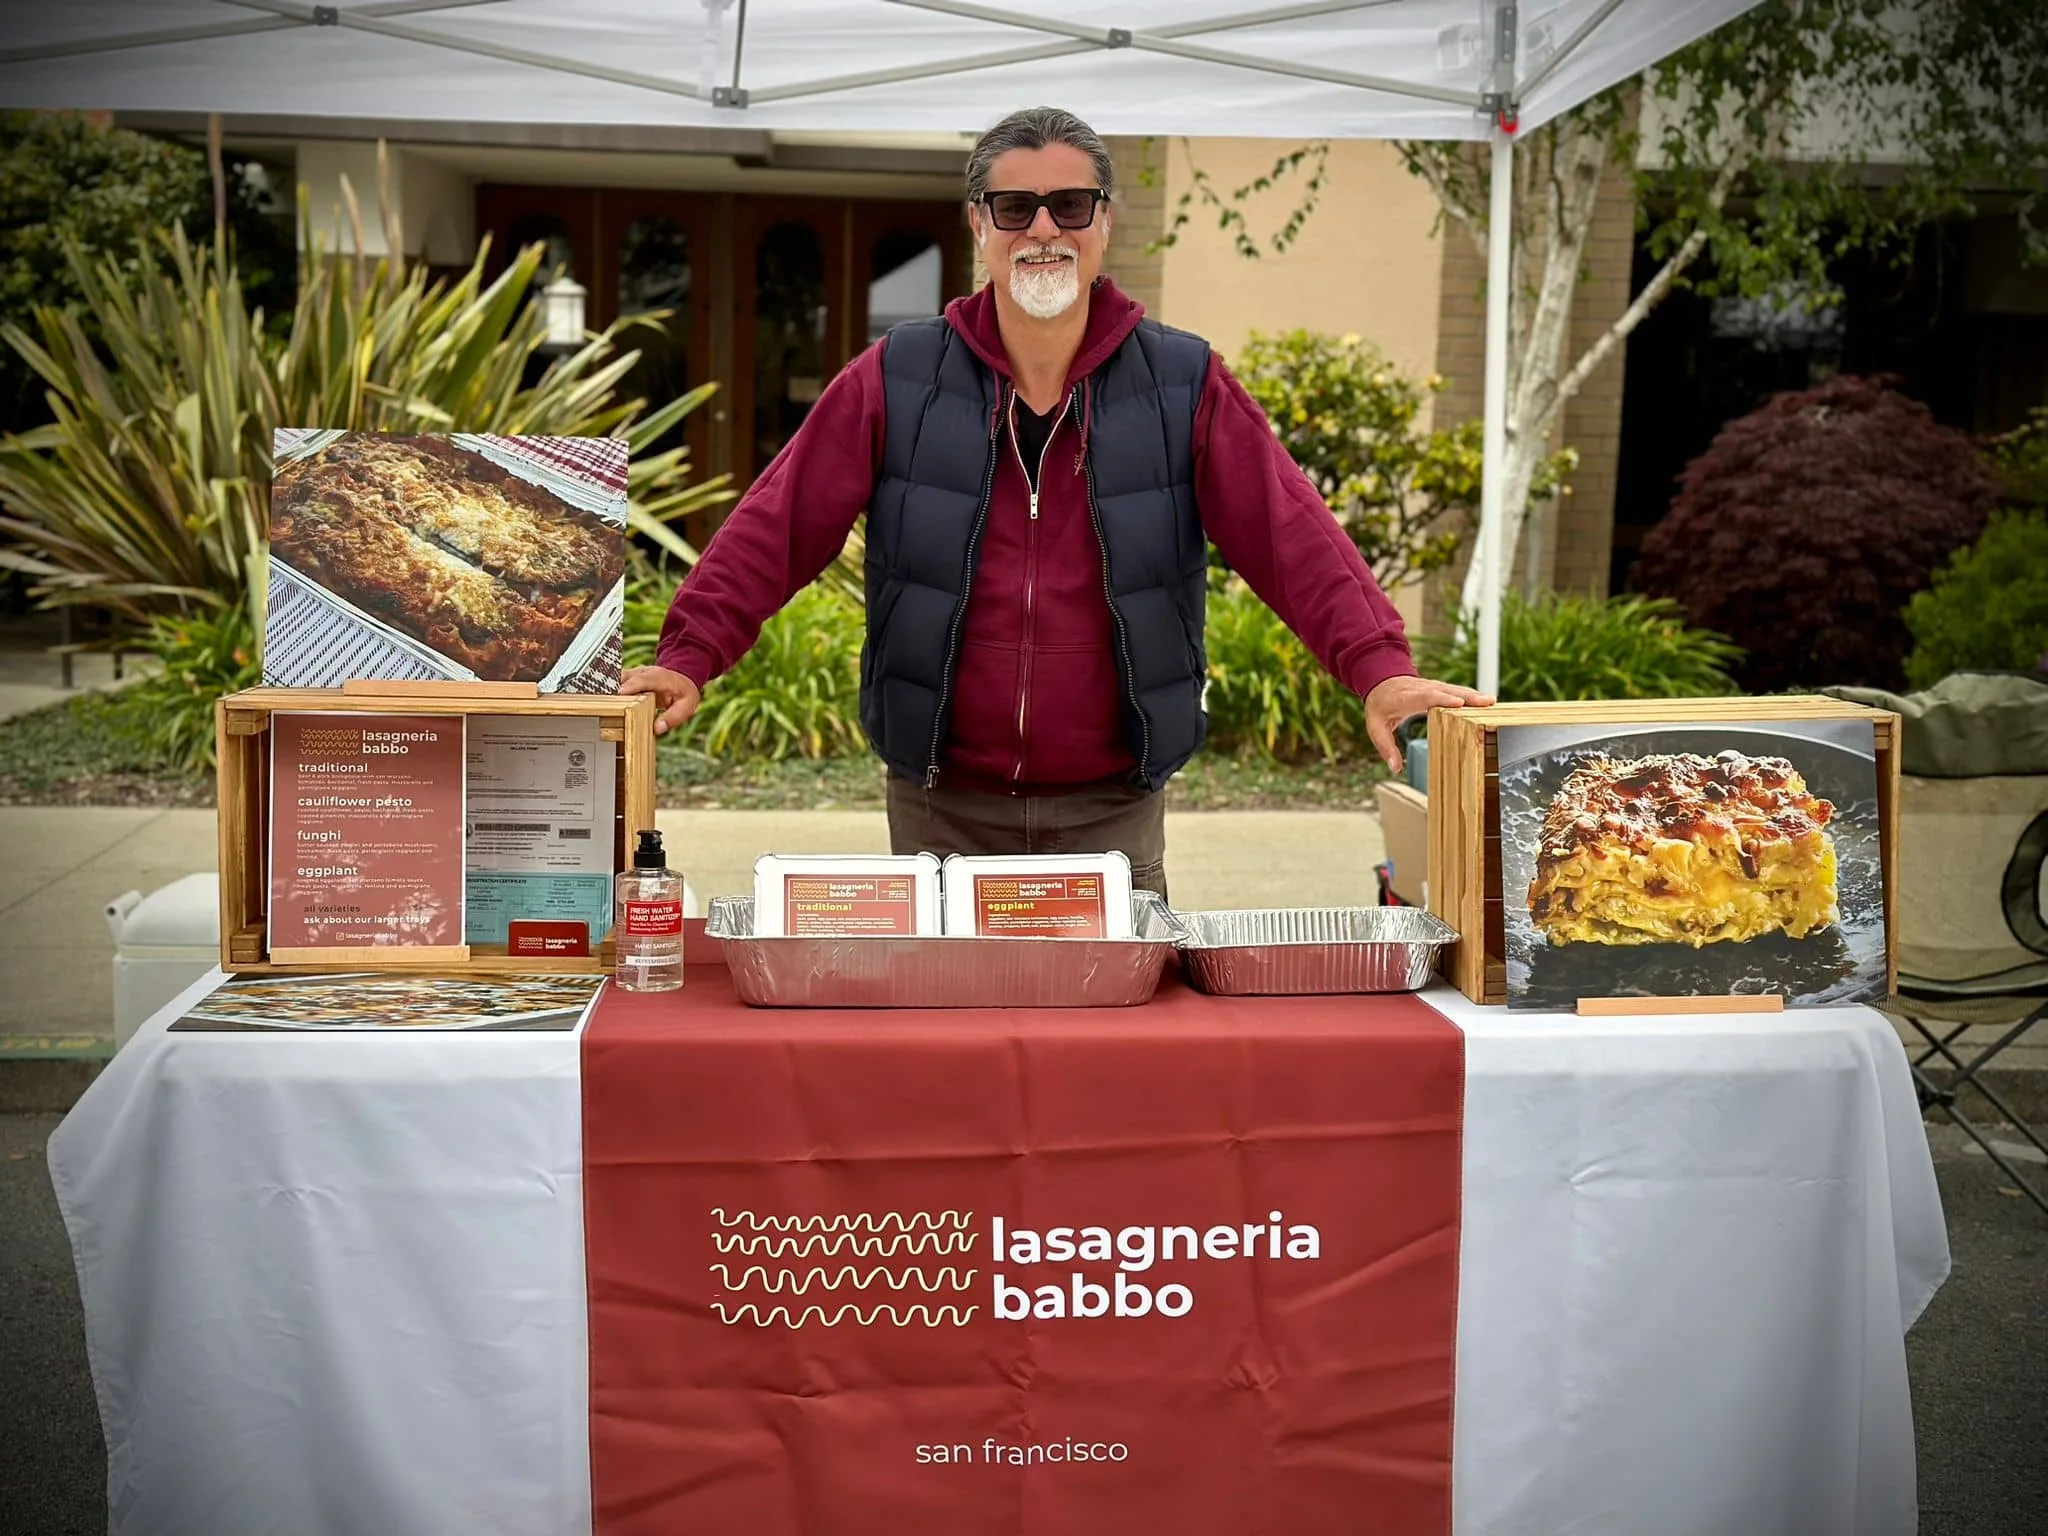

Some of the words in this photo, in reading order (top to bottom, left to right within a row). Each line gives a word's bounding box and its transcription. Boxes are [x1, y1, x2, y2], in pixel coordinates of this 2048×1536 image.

[362, 730, 438, 743] lasagneria
[362, 743, 409, 754] babbo
[298, 762, 368, 773] traditional
[297, 796, 371, 807] cauliflower
[375, 798, 412, 808] pesto
[297, 830, 341, 842] funghi
[297, 866, 358, 877] eggplant
[829, 882, 874, 891] lasagneria
[1019, 881, 1063, 890] lasagneria
[829, 890, 857, 898] babbo
[1019, 889, 1047, 897] babbo
[303, 905, 316, 913] all
[318, 904, 361, 913] varieties
[630, 907, 650, 915] FRESH
[651, 906, 673, 914] WATER
[797, 902, 852, 911] traditional
[987, 901, 1035, 911] eggplant
[303, 916, 320, 924] ask
[323, 916, 352, 924] about
[375, 916, 404, 925] larger
[991, 1211, 1320, 1271] lasagneria
[991, 1272, 1194, 1321] babbo
[914, 1441, 972, 1464] san
[982, 1436, 1129, 1466] francisco
